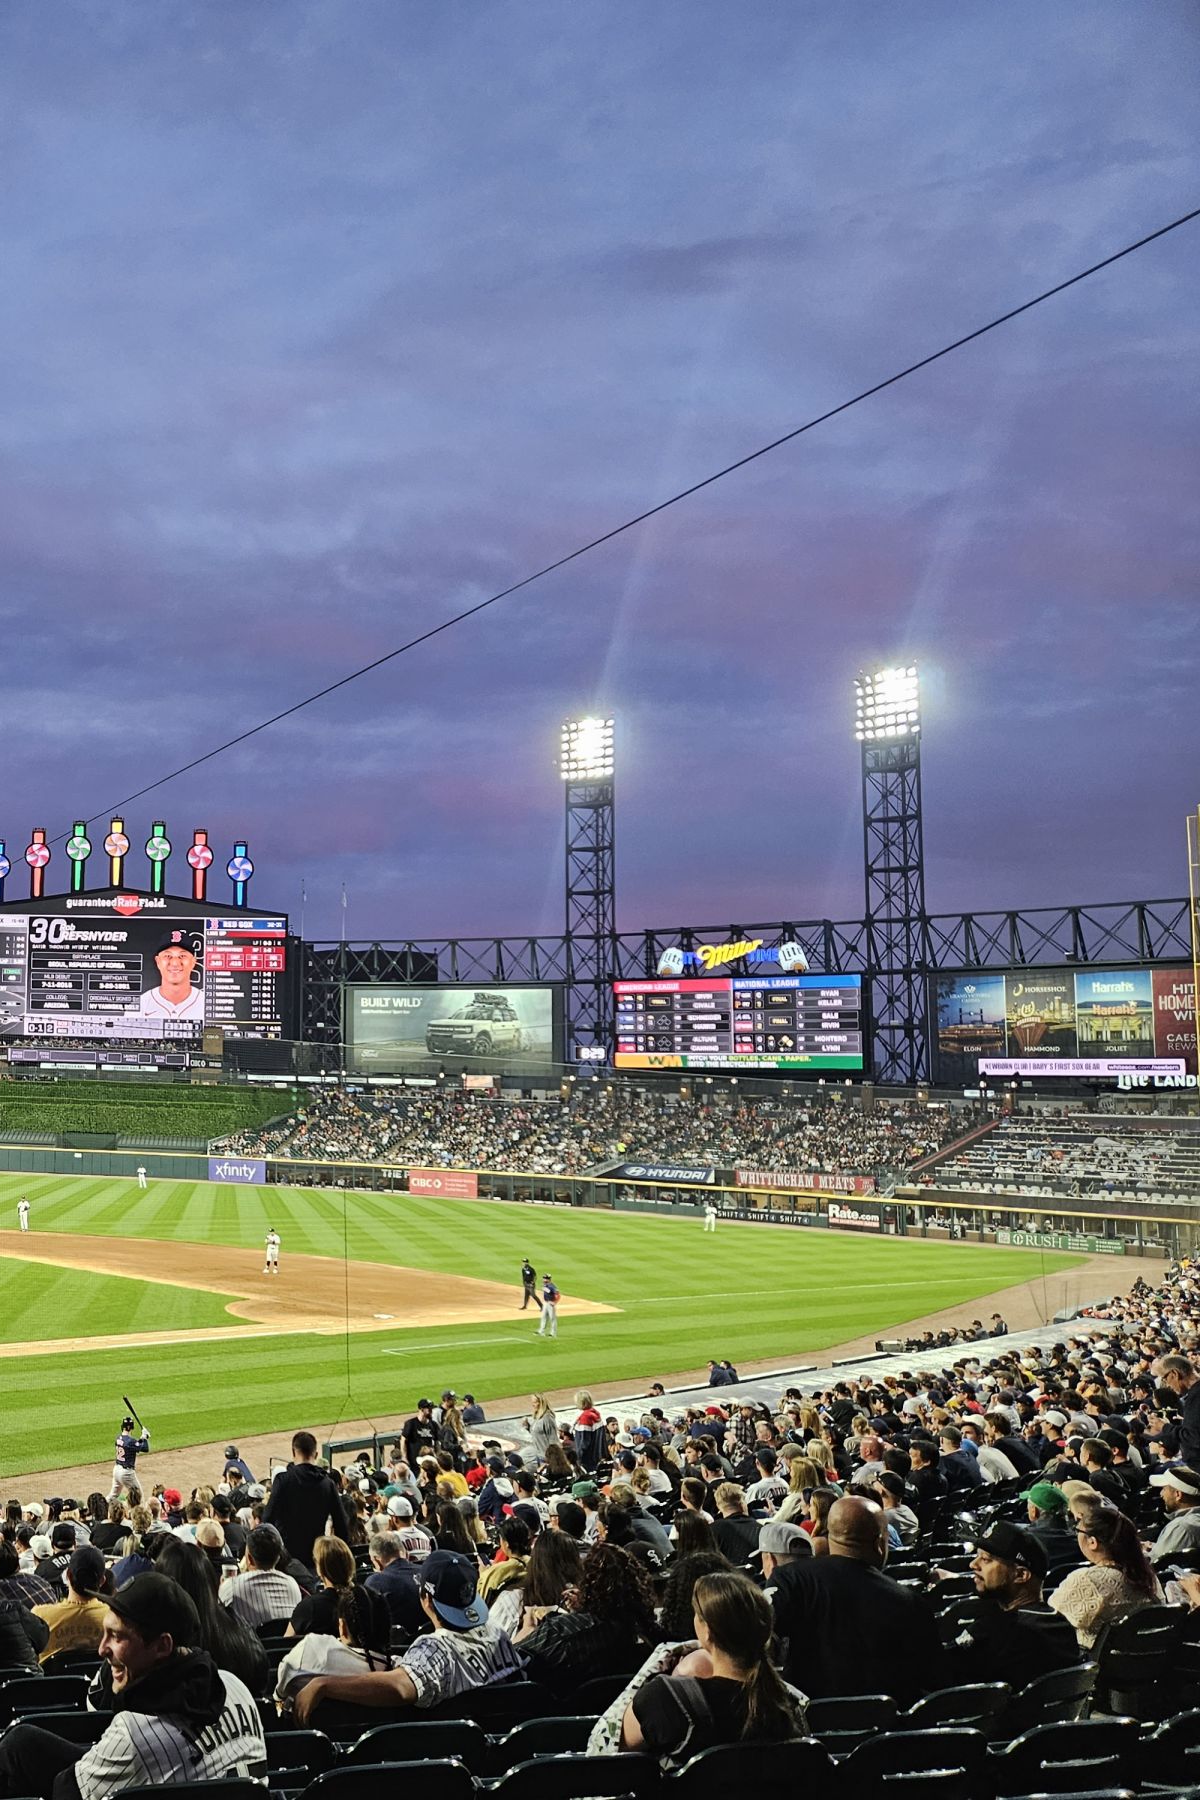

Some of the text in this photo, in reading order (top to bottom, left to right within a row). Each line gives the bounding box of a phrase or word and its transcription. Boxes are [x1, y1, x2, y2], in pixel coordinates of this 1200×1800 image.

[66, 898, 117, 908] guaranteed
[117, 898, 139, 907] Rate
[30, 918, 76, 944] 30 Rob
[62, 931, 128, 941] REFSNYDER
[664, 939, 803, 970] Lite Miller TIME Lite
[618, 982, 680, 991] AMERICAN LEAGUE
[734, 979, 800, 988] NATIONAL LEAGUE
[361, 997, 391, 1007] BUILT
[1159, 995, 1196, 1011] HOME
[1166, 1033, 1196, 1042] CAES
[1167, 1043, 1198, 1051] REWA
[1033, 1063, 1054, 1071] BABY'S
[1054, 1063, 1070, 1071] FIRST
[1117, 1074, 1150, 1090] Lite
[215, 1162, 257, 1180] xfinity
[381, 1169, 402, 1179] THE
[647, 1168, 706, 1180] HYUNDAI
[411, 1177, 433, 1188] CIBC
[738, 1171, 816, 1189] WHITTINGHAM
[818, 1177, 855, 1191] MEATS
[717, 1210, 802, 1223] SHIFT SHIFT SHIFT
[828, 1203, 879, 1221] Rate.com
[1026, 1234, 1062, 1248] RUSH
